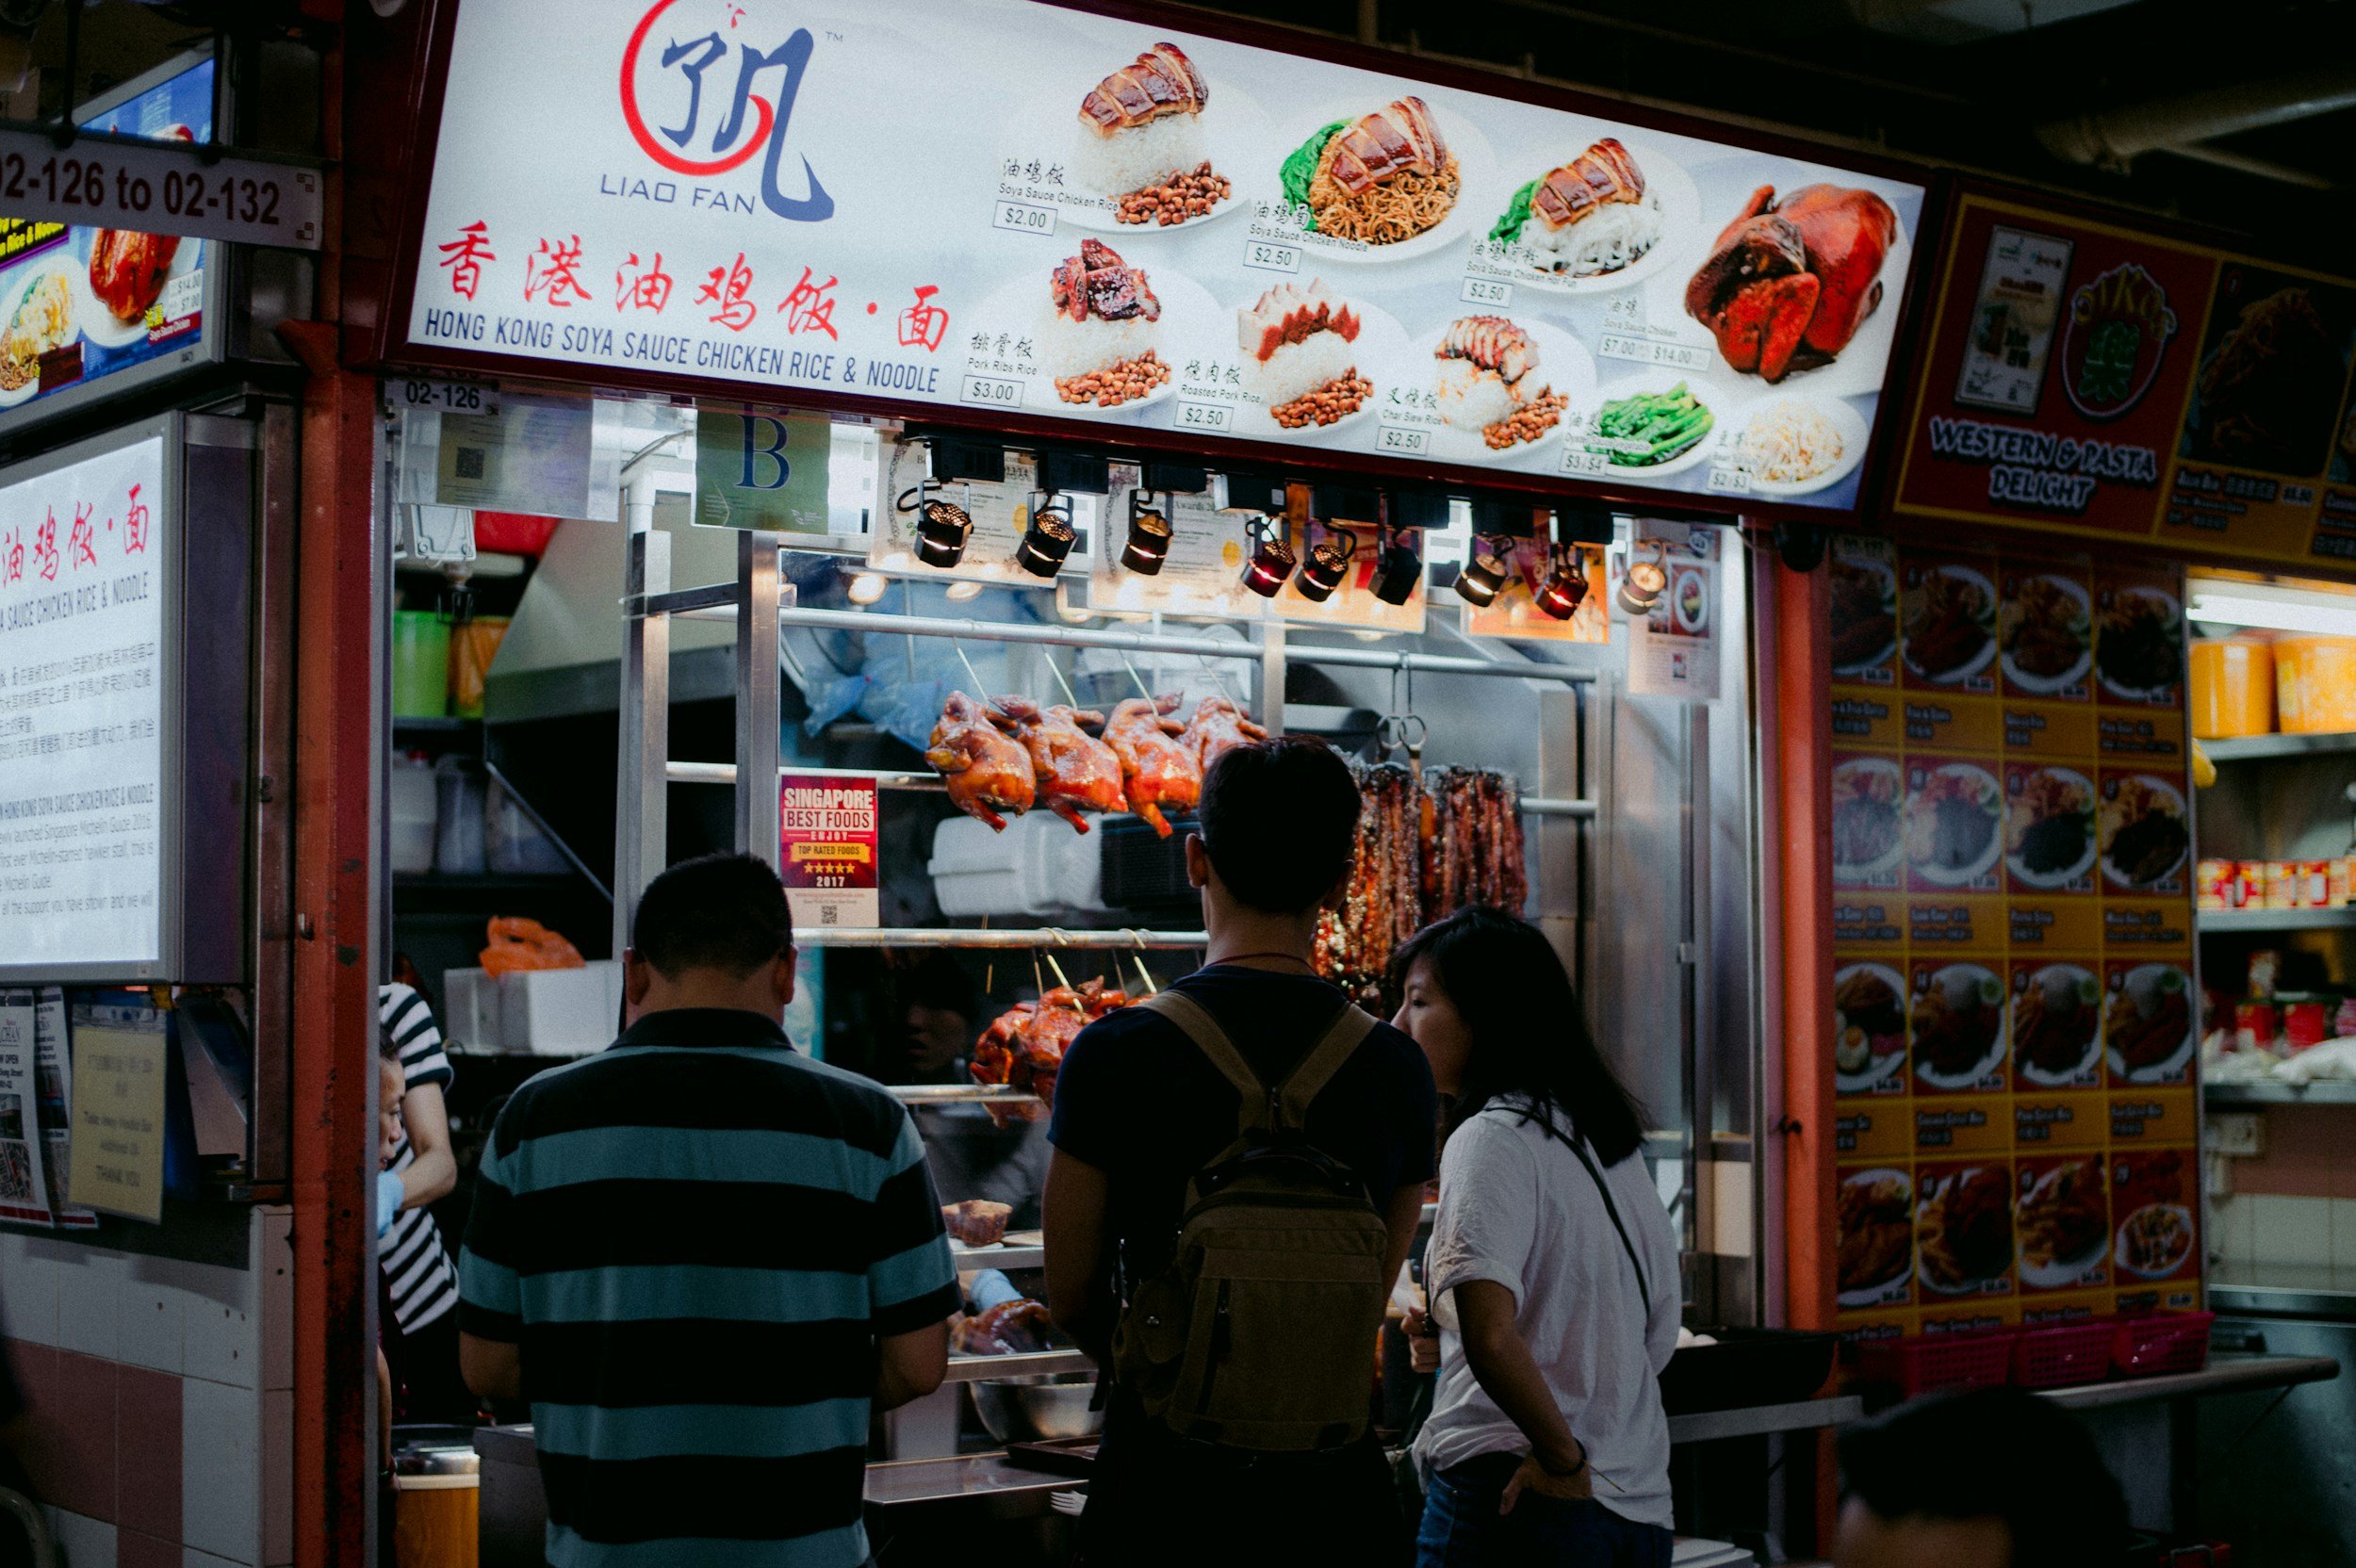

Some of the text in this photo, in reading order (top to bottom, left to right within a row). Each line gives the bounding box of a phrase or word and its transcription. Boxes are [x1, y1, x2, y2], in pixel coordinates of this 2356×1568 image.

[0, 154, 280, 224] 2-126 to 02-132
[600, 174, 756, 215] LIAO FAN
[999, 183, 1120, 212] Soya Sauce Chicken Rice
[1006, 208, 1047, 228] $2.00
[1250, 223, 1271, 237] Soya
[1273, 228, 1300, 241] Sauce
[1302, 232, 1336, 247] Chicken
[1255, 248, 1292, 266] $2.50
[1469, 283, 1505, 302] $2.50
[425, 308, 940, 393] HONG KONG SOYA SAUCE CHICKEN RICE & NOODLE
[1604, 337, 1692, 364] $7.00 $14.00
[968, 357, 1038, 376] Pork Ribs Rice
[406, 381, 480, 409] 02-126
[973, 382, 1014, 400] $3.00
[1180, 384, 1261, 403] Roasted Pork Rice
[1186, 407, 1223, 425] $2.50
[1383, 409, 1402, 420] Char
[1386, 432, 1421, 449] $2.50
[1930, 416, 2058, 466] WESTERN
[2080, 440, 2157, 481] PASTA
[733, 415, 790, 489] B
[1989, 466, 2094, 508] DELIGHT
[8, 571, 148, 630] SAUCE CHICKEN RICE & NOODLE
[784, 788, 874, 809] SINGAPORE
[787, 810, 870, 828] BEST FOODS
[810, 831, 848, 841] ENJOY
[799, 845, 860, 855] TOP RATED FOODS
[816, 876, 844, 888] 2017
